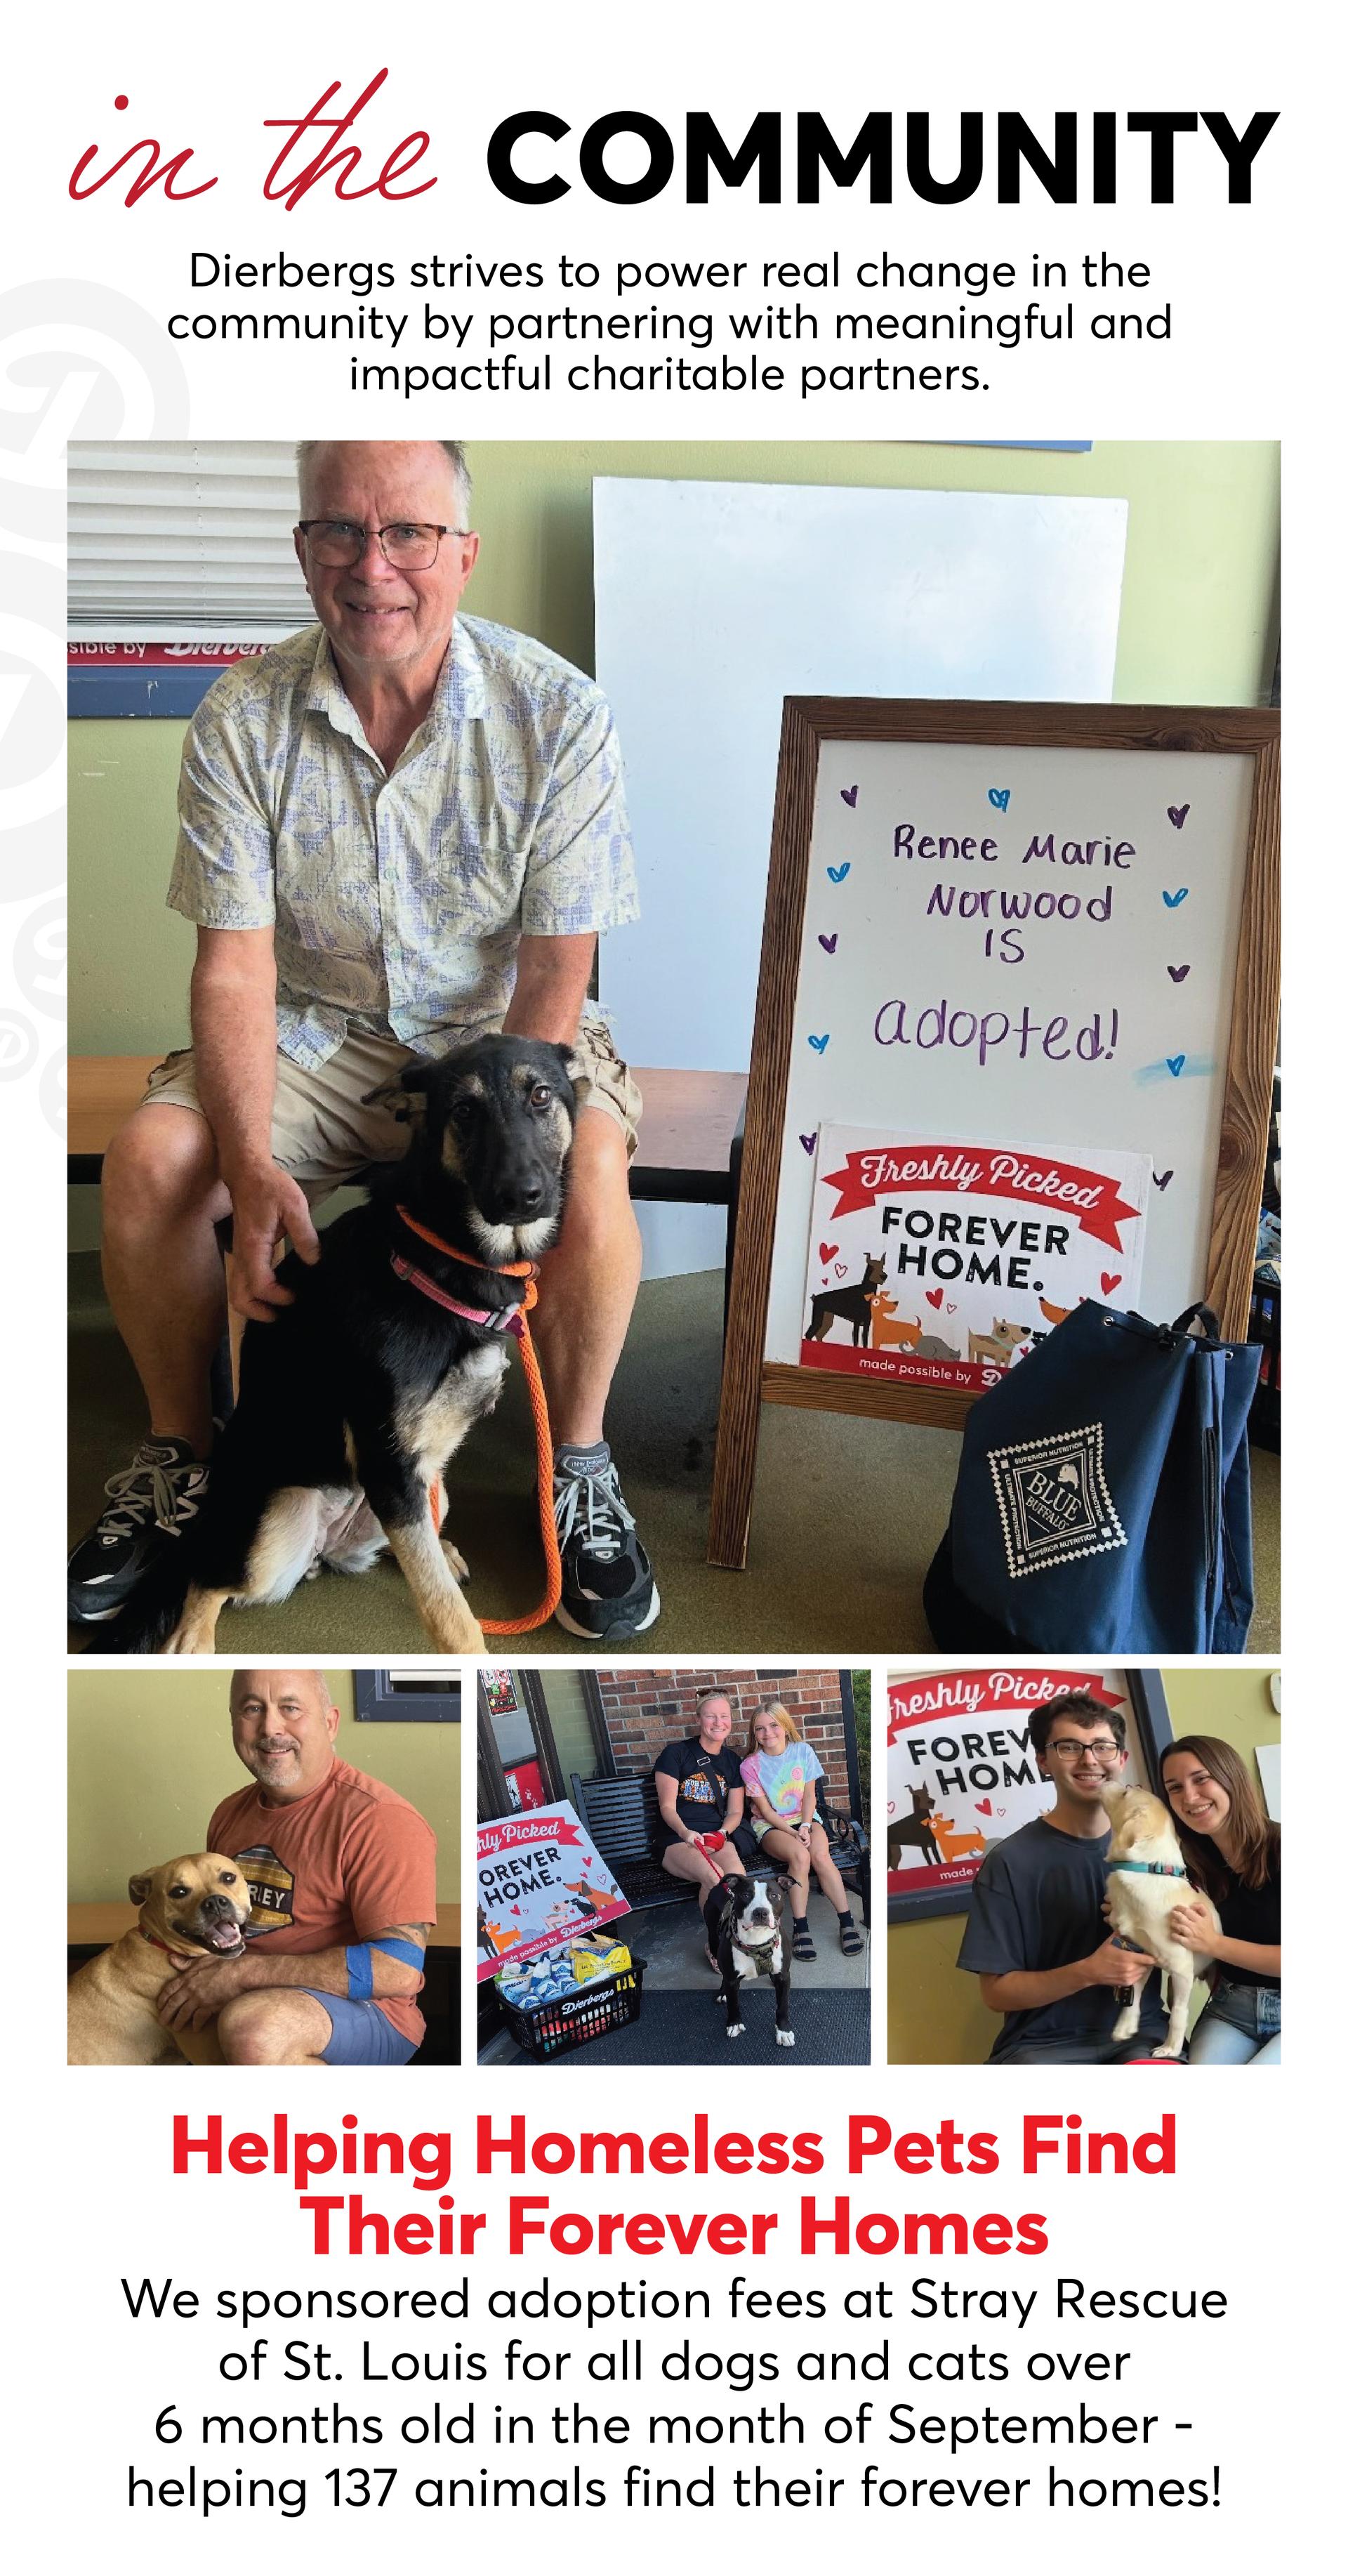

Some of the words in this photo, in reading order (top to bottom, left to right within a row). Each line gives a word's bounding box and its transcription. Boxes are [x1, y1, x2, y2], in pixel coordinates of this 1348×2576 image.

[894, 824, 998, 861] Renee
[1022, 834, 1136, 869] Marie
[927, 883, 1112, 922] Norwood
[985, 928, 1024, 963] IS
[860, 1154, 984, 1190] Freshly
[990, 1155, 1104, 1209] Picked
[882, 1206, 1069, 1255] FOREVER
[898, 1243, 1044, 1291] HOME.
[859, 1359, 896, 1371] made
[899, 1365, 952, 1380] possible
[956, 1371, 971, 1385] by
[1015, 1452, 1048, 1465] SUPERIOR
[1049, 1441, 1084, 1456] NUTRITION
[1026, 1471, 1081, 1521] BLUE
[907, 1728, 1033, 1765] FOREV
[502, 1821, 560, 1842] Picked
[479, 1847, 562, 1886] OREVER
[939, 1867, 974, 1879] made
[484, 1869, 562, 1908] HOME.
[498, 1955, 518, 1966] made
[520, 1941, 548, 1959] possible
[560, 1915, 602, 1938] Dierbergs
[562, 1988, 614, 2015] Dierbergs
